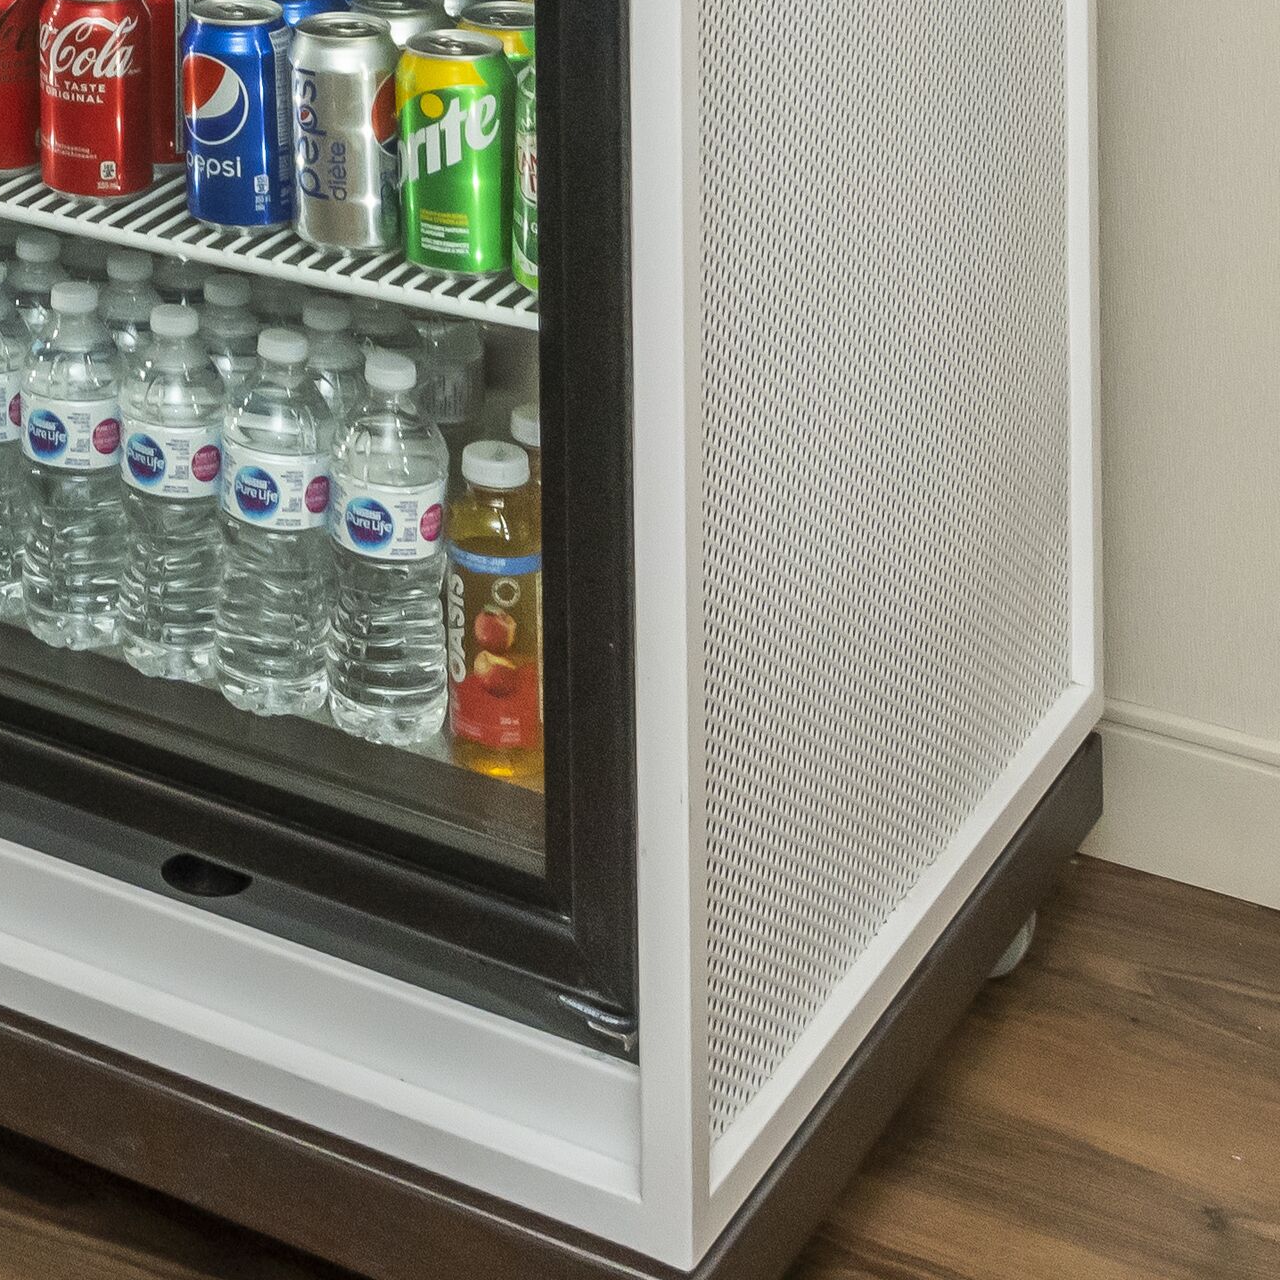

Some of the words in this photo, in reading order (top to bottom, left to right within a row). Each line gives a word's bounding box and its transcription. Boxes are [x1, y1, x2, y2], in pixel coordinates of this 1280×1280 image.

[46, 88, 105, 105] ORIGINAL
[64, 80, 106, 94] TASTE
[296, 67, 330, 200] pepsi
[186, 151, 242, 179] pepsi
[327, 140, 348, 202] diète
[29, 425, 48, 440] Pure
[48, 430, 67, 447] Life
[128, 448, 146, 464] Pure
[146, 455, 166, 473] Life
[235, 481, 258, 499] Pure
[258, 488, 279, 506] Life
[347, 511, 371, 530] Pure
[372, 517, 394, 537] Life
